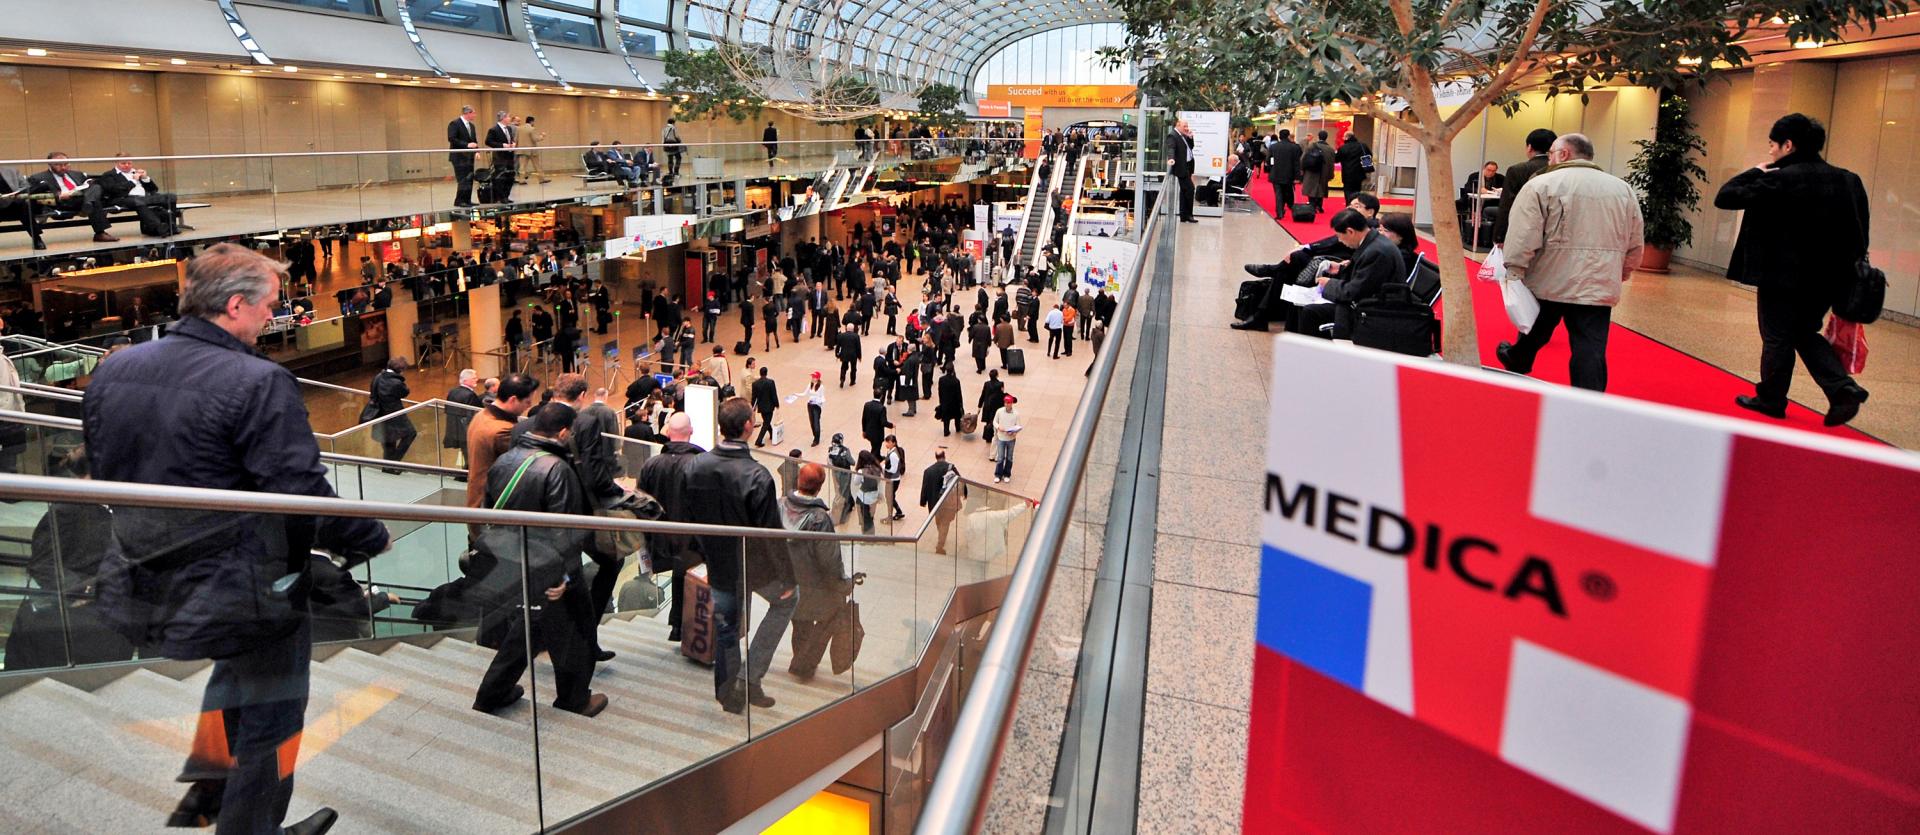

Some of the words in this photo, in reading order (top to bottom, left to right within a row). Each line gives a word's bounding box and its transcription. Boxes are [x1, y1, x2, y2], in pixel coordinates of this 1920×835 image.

[1007, 86, 1042, 96] Succeed
[1044, 88, 1058, 96] with
[1264, 471, 1570, 620] MEDICA
